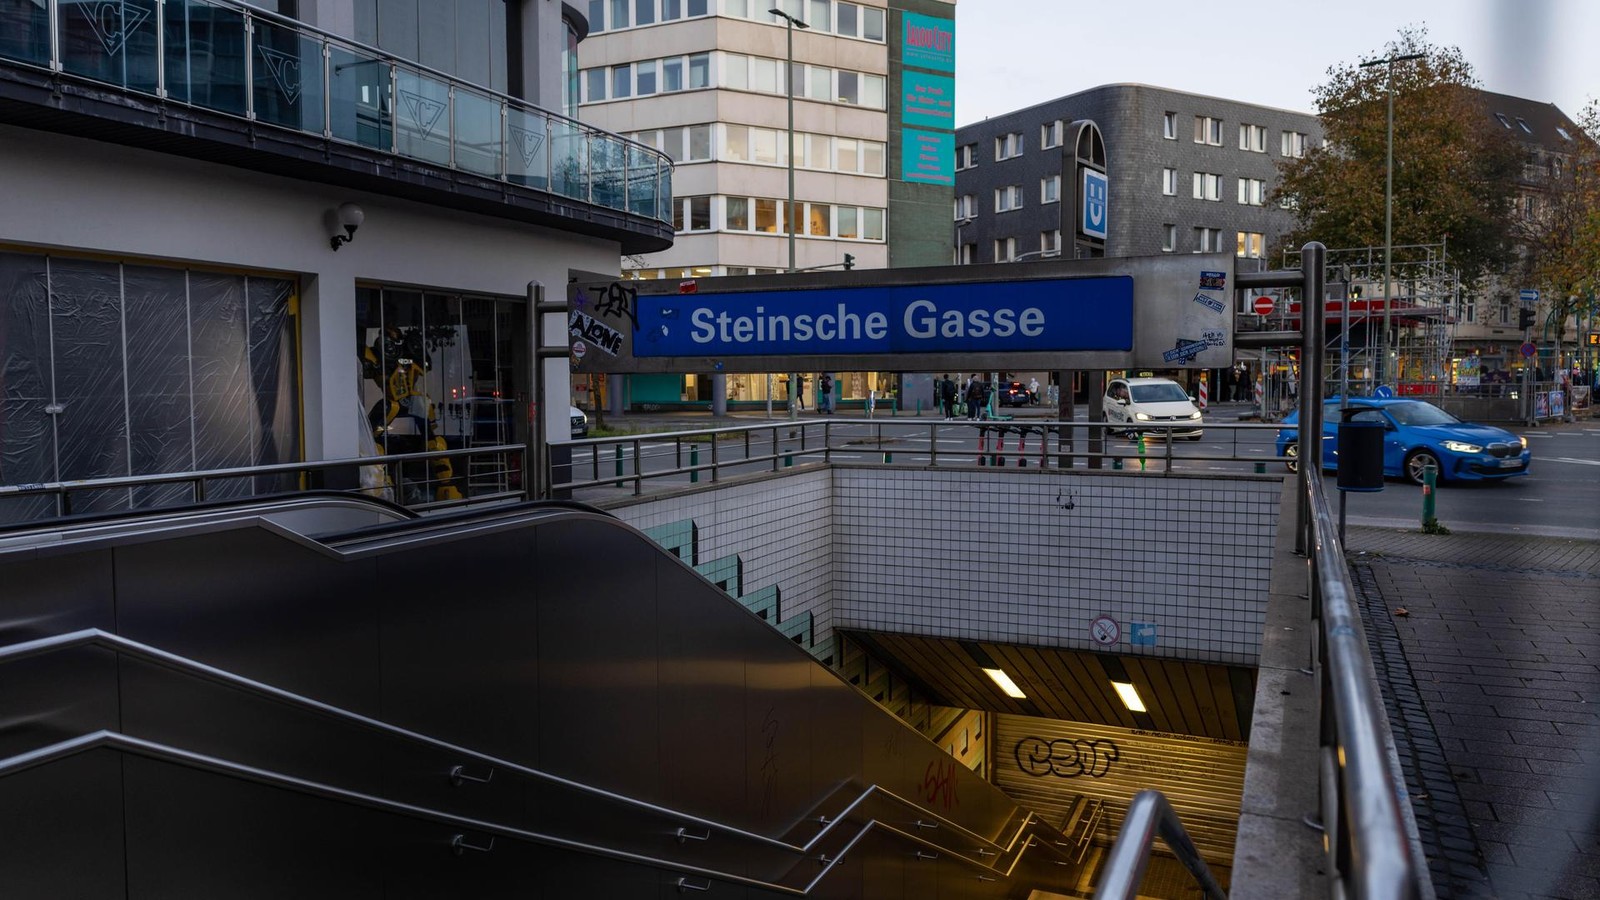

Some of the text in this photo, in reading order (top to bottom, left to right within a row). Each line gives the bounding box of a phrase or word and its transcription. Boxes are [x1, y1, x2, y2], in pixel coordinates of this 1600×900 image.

[570, 314, 623, 355] ALONE
[691, 300, 1046, 344] Steinsche Gasse
